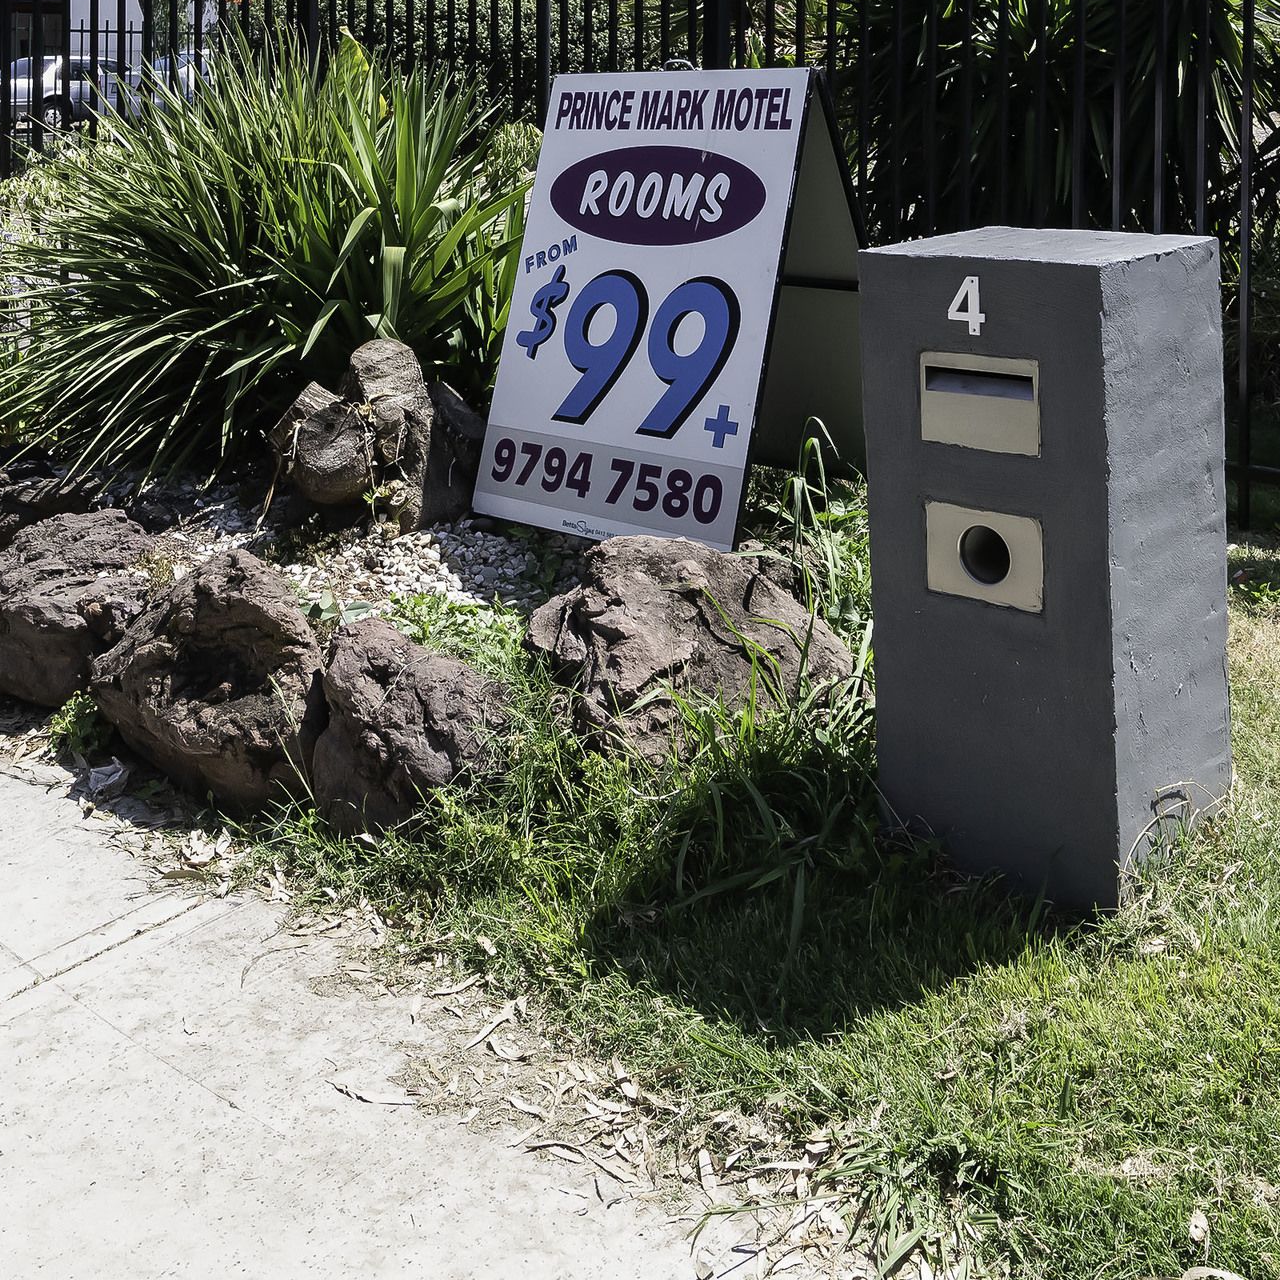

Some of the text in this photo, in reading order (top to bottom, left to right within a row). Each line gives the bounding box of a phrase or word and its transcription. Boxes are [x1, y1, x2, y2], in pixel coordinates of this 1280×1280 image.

[555, 87, 793, 131] PRINCE MARK MOTEL
[578, 169, 731, 224] ROOMS
[525, 235, 578, 274] FROM
[948, 275, 986, 336] 4
[491, 437, 724, 526] 9794 7580
